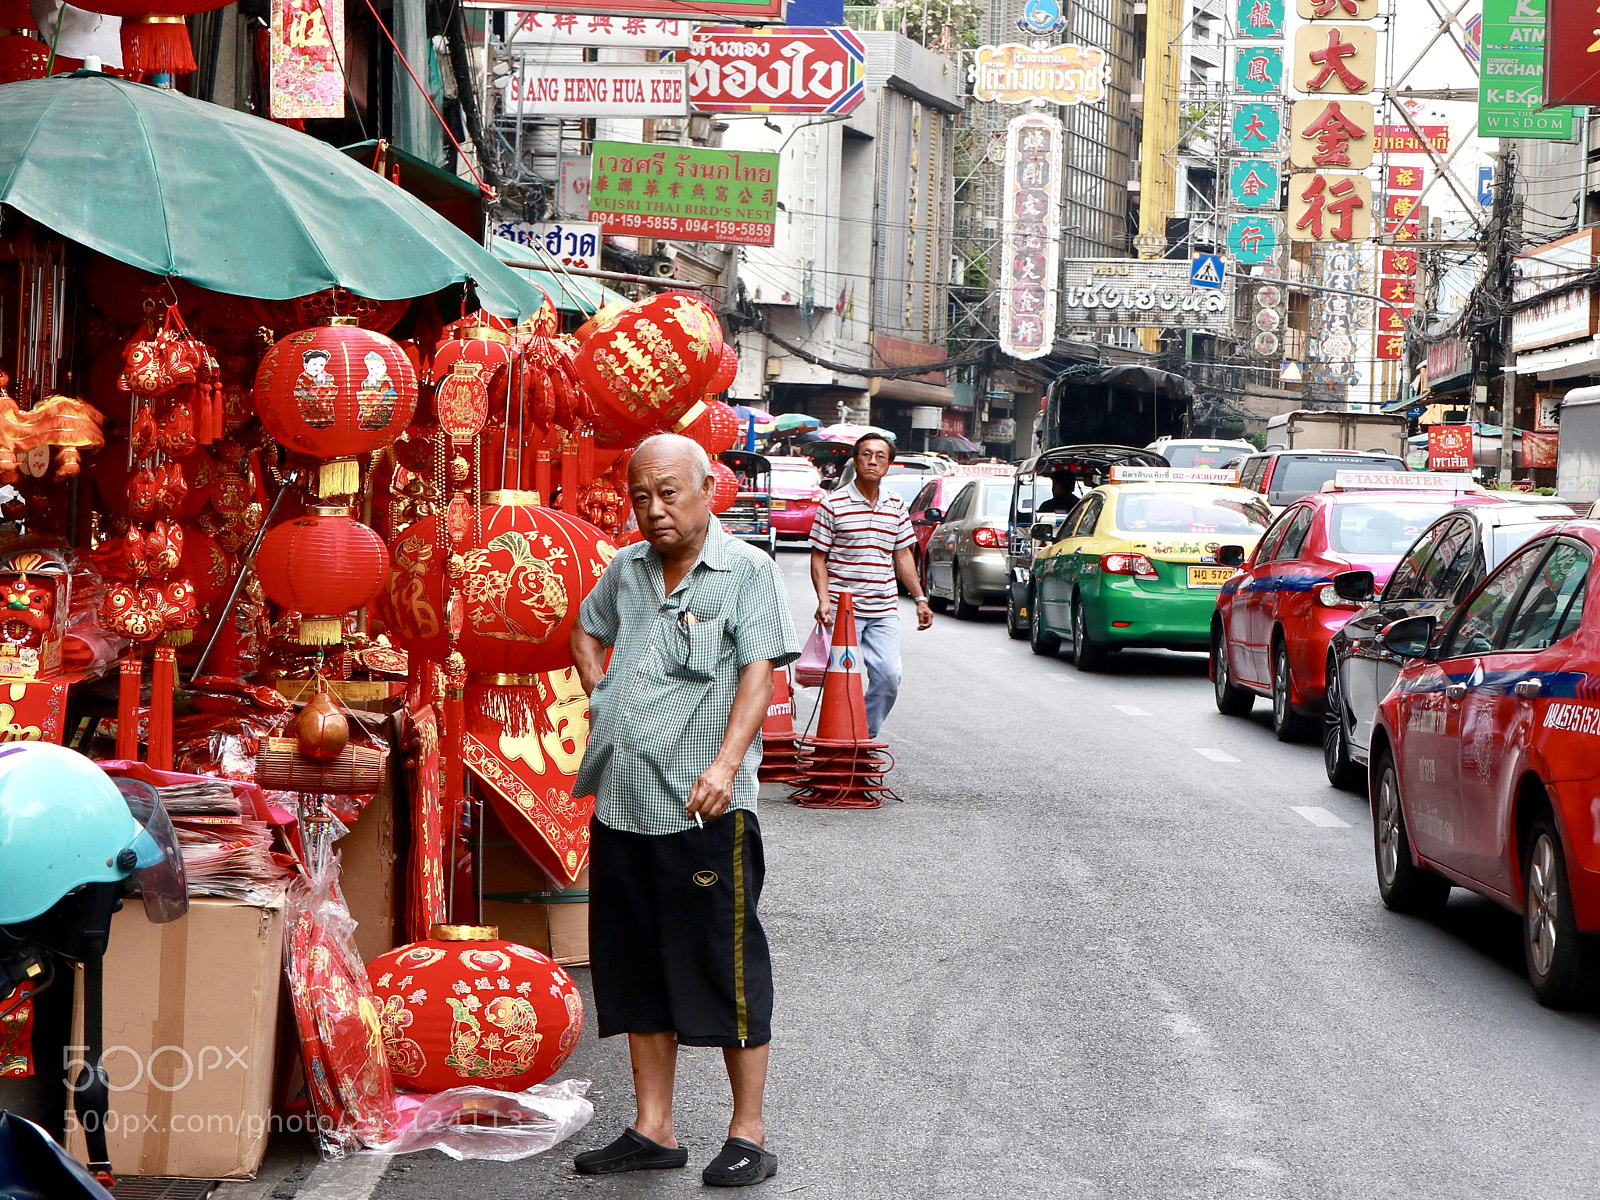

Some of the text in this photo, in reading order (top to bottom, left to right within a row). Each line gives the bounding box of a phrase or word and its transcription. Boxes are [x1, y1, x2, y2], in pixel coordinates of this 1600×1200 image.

[290, 8, 329, 48] 旺
[1509, 28, 1545, 42] ATM
[511, 77, 682, 103] SANG HENG HUA KEE
[1239, 2, 1275, 255] 龍鳳大金行
[1487, 117, 1563, 129] WISDOM
[598, 152, 773, 183] เวชศรี รังนกไทย
[594, 198, 641, 211] VEJSRI
[645, 201, 681, 214] THAI
[685, 204, 732, 218] BIRD'S
[736, 208, 773, 220] NEST
[686, 220, 772, 237] 094-159-5859
[1432, 453, 1469, 467] เกาลัด
[962, 466, 1009, 475] TAXI-METER
[1355, 474, 1443, 486] TAXI-METER
